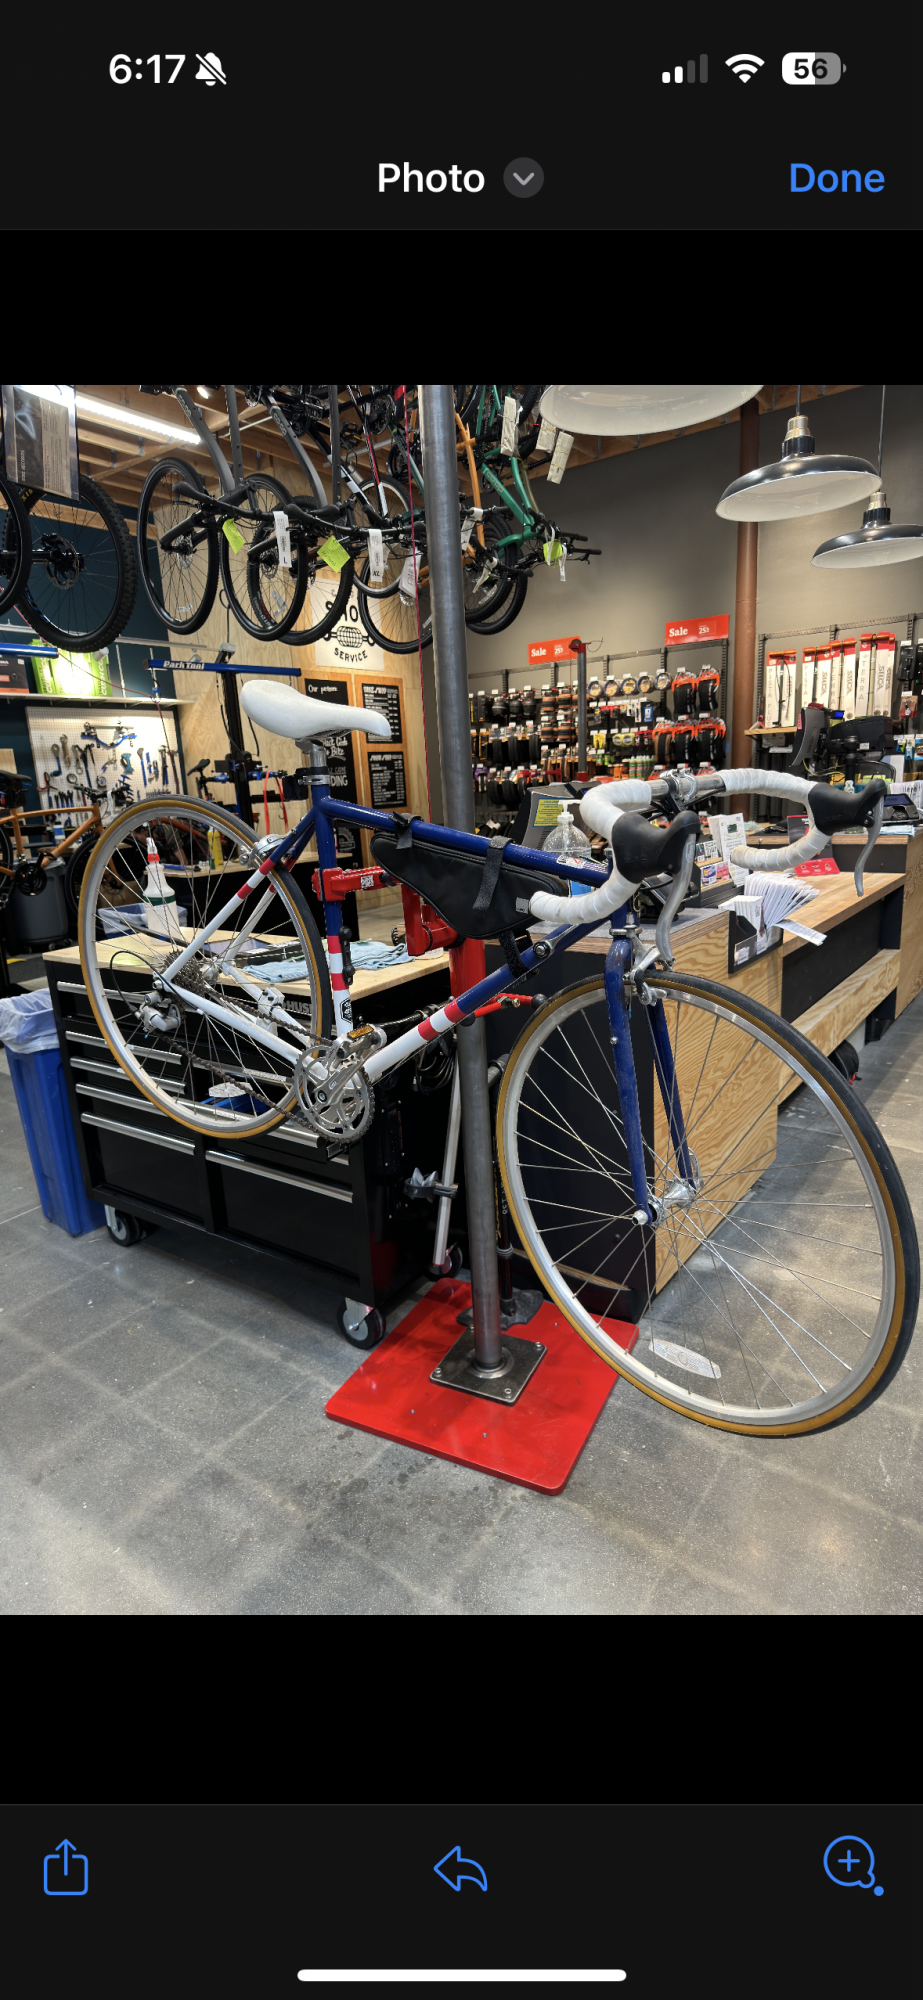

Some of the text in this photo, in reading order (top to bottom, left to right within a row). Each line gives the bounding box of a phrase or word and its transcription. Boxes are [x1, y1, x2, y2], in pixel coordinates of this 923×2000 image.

[372, 570, 381, 578] XL
[668, 626, 688, 638] Sale
[334, 647, 368, 663] SERVICE
[531, 646, 547, 658] Sale
[858, 660, 867, 701] TERRA
[330, 775, 348, 787] DING
[286, 1000, 312, 1014] HUS
